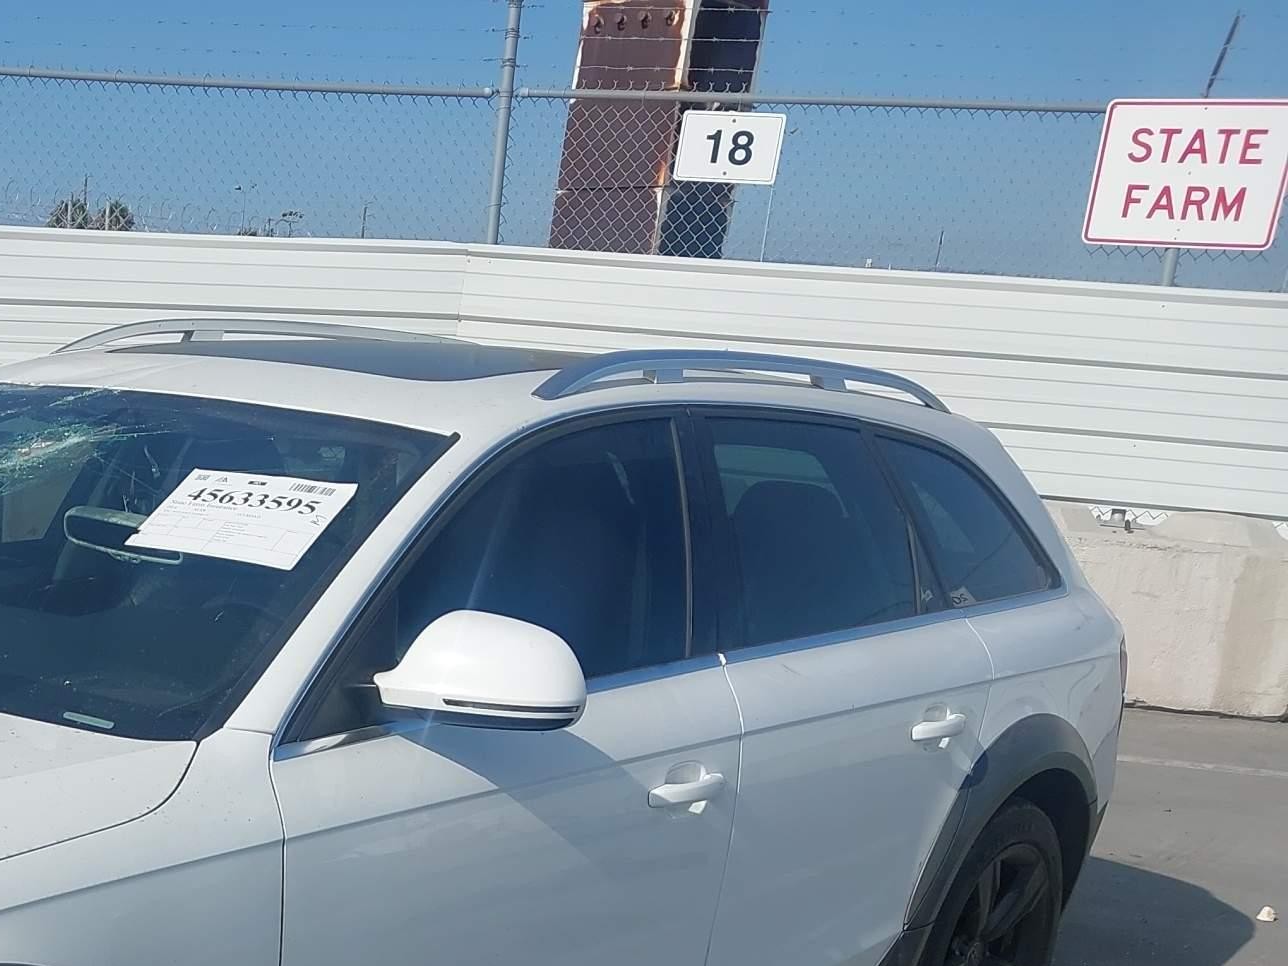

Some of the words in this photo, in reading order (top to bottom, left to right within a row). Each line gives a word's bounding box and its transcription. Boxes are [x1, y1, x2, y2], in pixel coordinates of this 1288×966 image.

[706, 129, 755, 166] 18
[1127, 127, 1270, 165] STATE
[1120, 184, 1248, 222] FARM
[187, 487, 323, 515] 45633595
